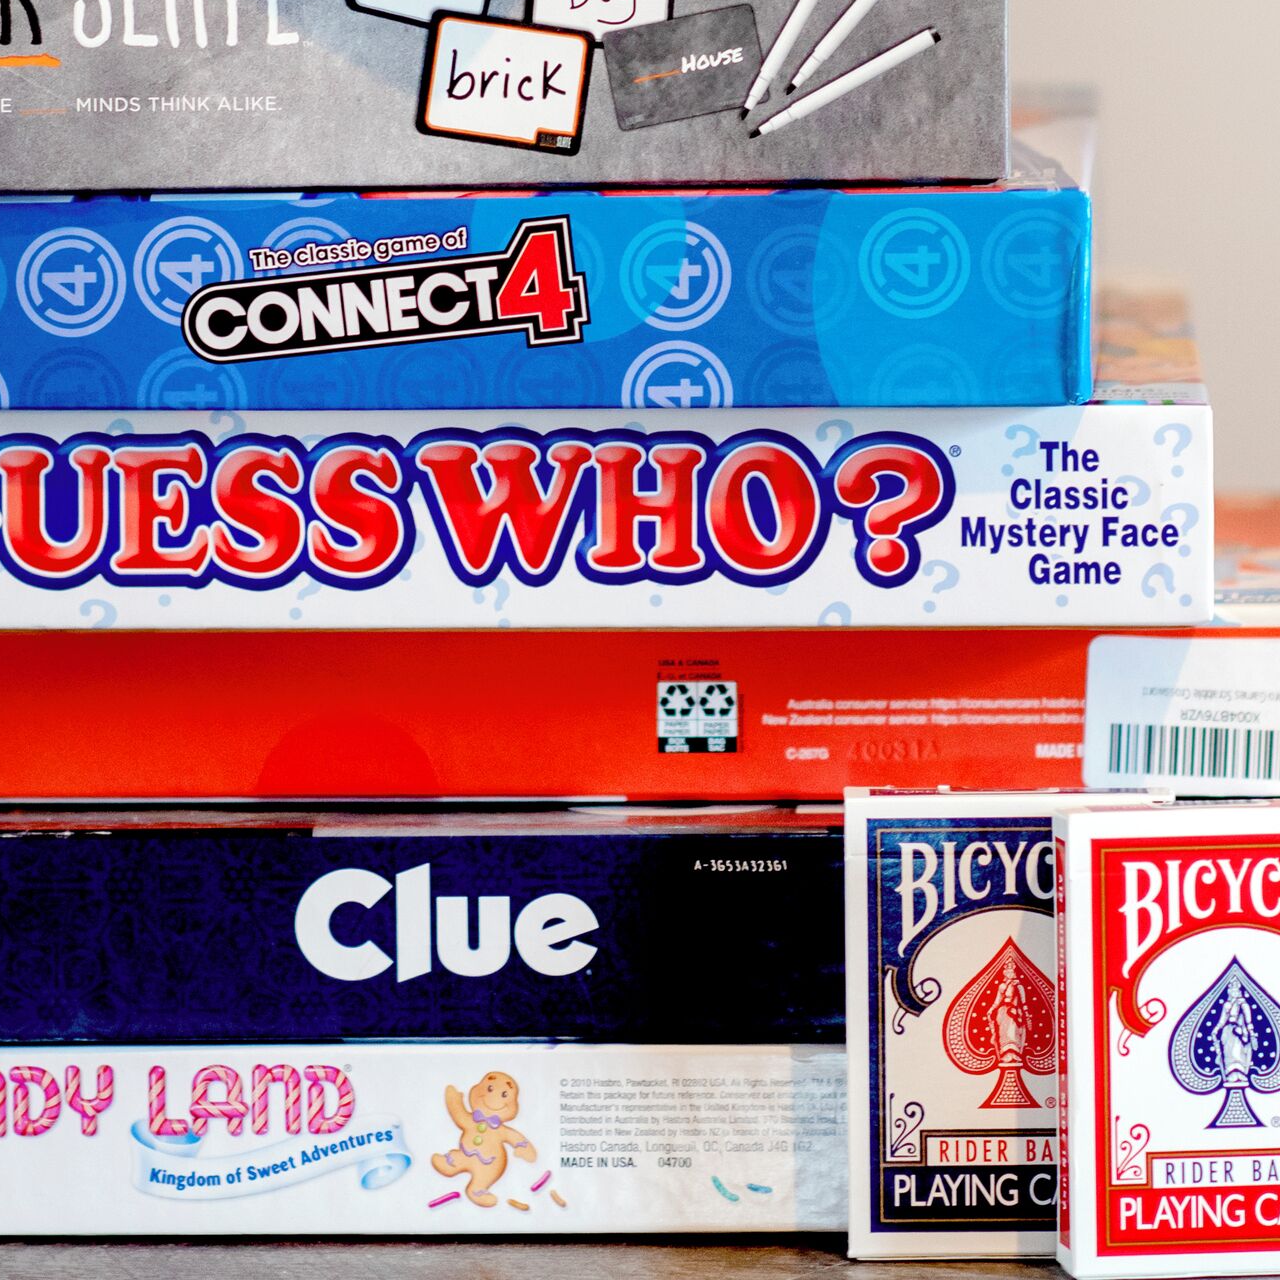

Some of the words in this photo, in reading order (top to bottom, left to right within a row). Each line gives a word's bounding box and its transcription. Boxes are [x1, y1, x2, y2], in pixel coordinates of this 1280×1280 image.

[446, 48, 567, 103] brick
[681, 47, 743, 74] HOUSE
[76, 98, 140, 113] MINDS
[148, 97, 211, 112] THINK
[217, 96, 282, 112] ALIKE.
[251, 249, 291, 271] The
[293, 237, 371, 267] classic
[374, 233, 438, 260] game
[441, 227, 467, 250] of
[195, 267, 502, 350] CONNECT
[1039, 441, 1099, 472] The
[416, 432, 948, 582] WHO?
[1010, 478, 1129, 510] Classic
[960, 517, 1089, 554] Mystery
[1102, 517, 1179, 547] Face
[1028, 554, 1121, 585] Game
[1036, 743, 1075, 759] MADE
[896, 839, 1055, 958] BICYC
[294, 863, 599, 982] Clue
[148, 1064, 355, 1135] LAND
[149, 1167, 222, 1191] Kingdom
[226, 1167, 244, 1186] of
[247, 1154, 296, 1183] Sweet
[300, 1127, 395, 1168] Adventures
[560, 1140, 597, 1154] Hasbro
[560, 1157, 593, 1169] MADE
[596, 1157, 609, 1169] IN
[612, 1157, 638, 1169] USA.
[938, 1137, 1008, 1164] RIDER
[1026, 1137, 1054, 1163] BA
[1165, 1157, 1233, 1185] RIDER
[894, 1174, 1019, 1207] PLAYING
[1121, 1194, 1246, 1230] PLAYING
